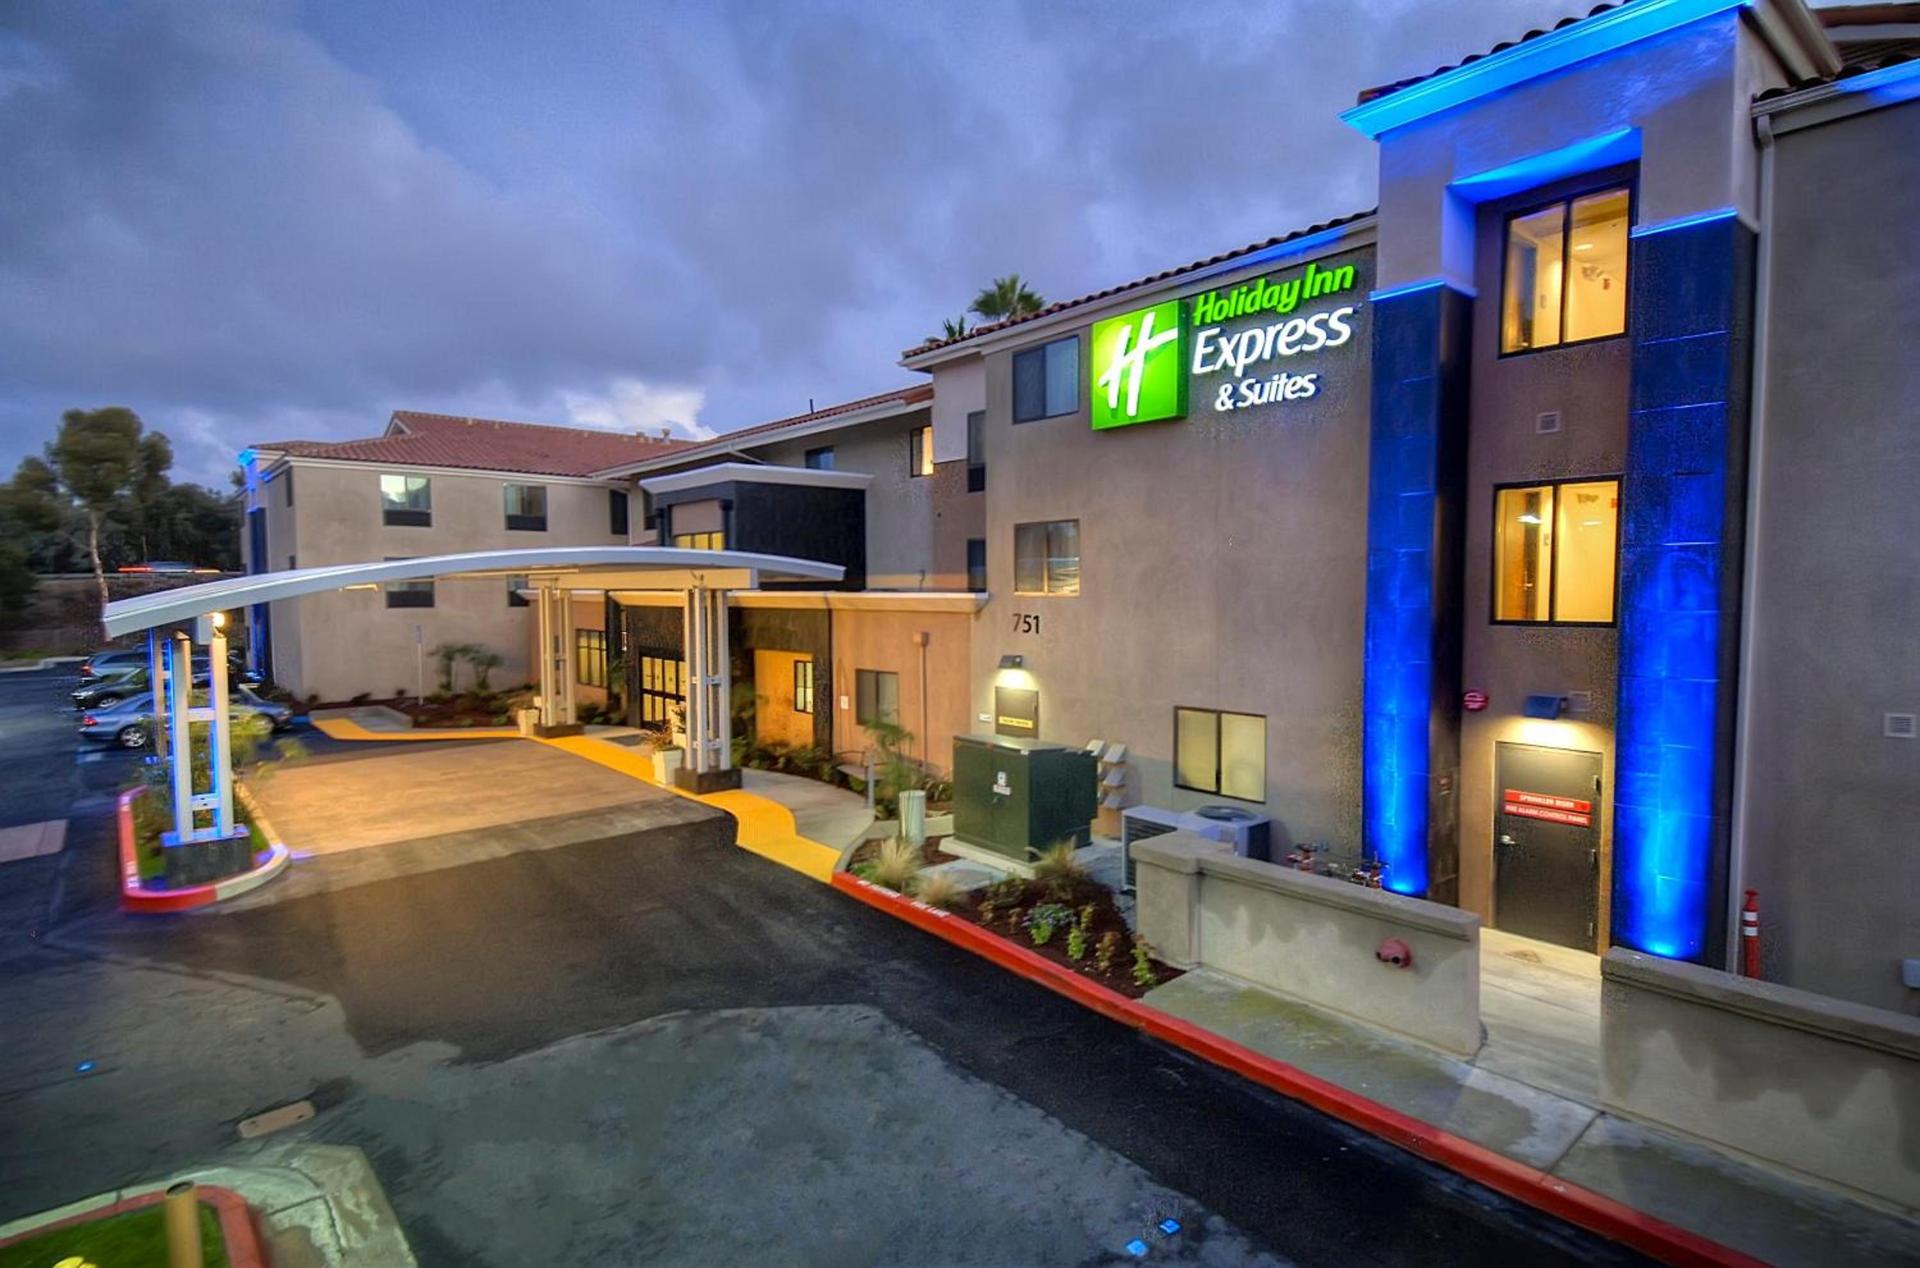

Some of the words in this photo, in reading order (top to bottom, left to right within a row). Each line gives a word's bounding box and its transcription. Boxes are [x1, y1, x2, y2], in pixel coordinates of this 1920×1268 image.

[1193, 278, 1300, 325] Holiday
[1302, 263, 1354, 298] Inn
[1192, 307, 1353, 377] Express
[1215, 383, 1234, 411] &
[1236, 373, 1317, 407] Suites
[1012, 613, 1040, 634] 751
